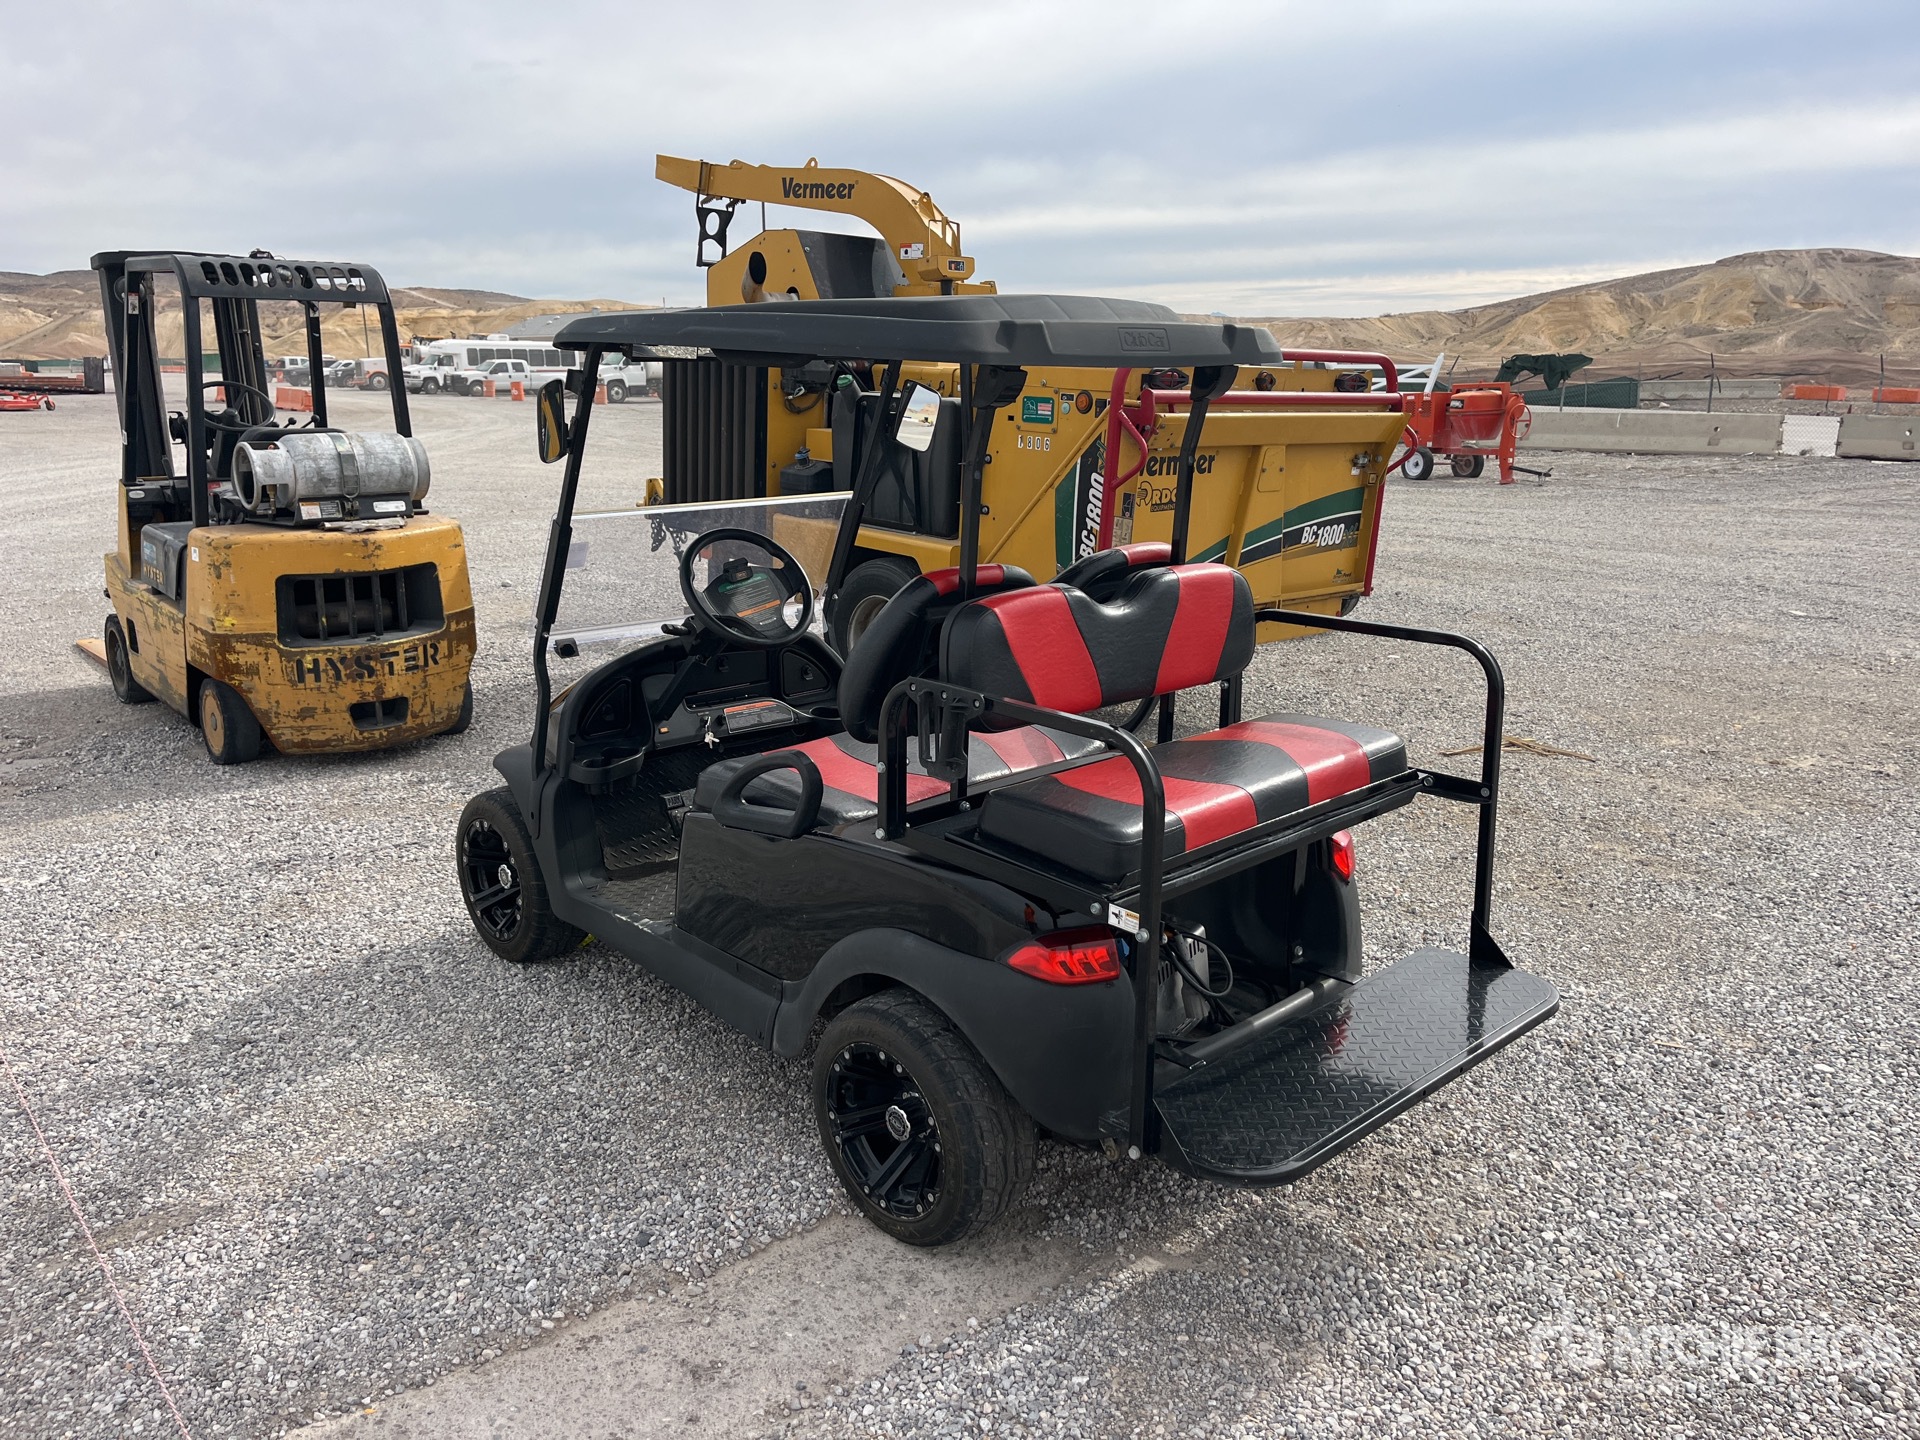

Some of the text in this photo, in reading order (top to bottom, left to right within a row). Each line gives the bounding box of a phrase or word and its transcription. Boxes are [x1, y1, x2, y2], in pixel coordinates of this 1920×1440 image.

[782, 177, 855, 200] Vermeer
[1140, 454, 1216, 477] ermer
[143, 565, 164, 585] HYSTER
[296, 642, 440, 684] HYSTER
